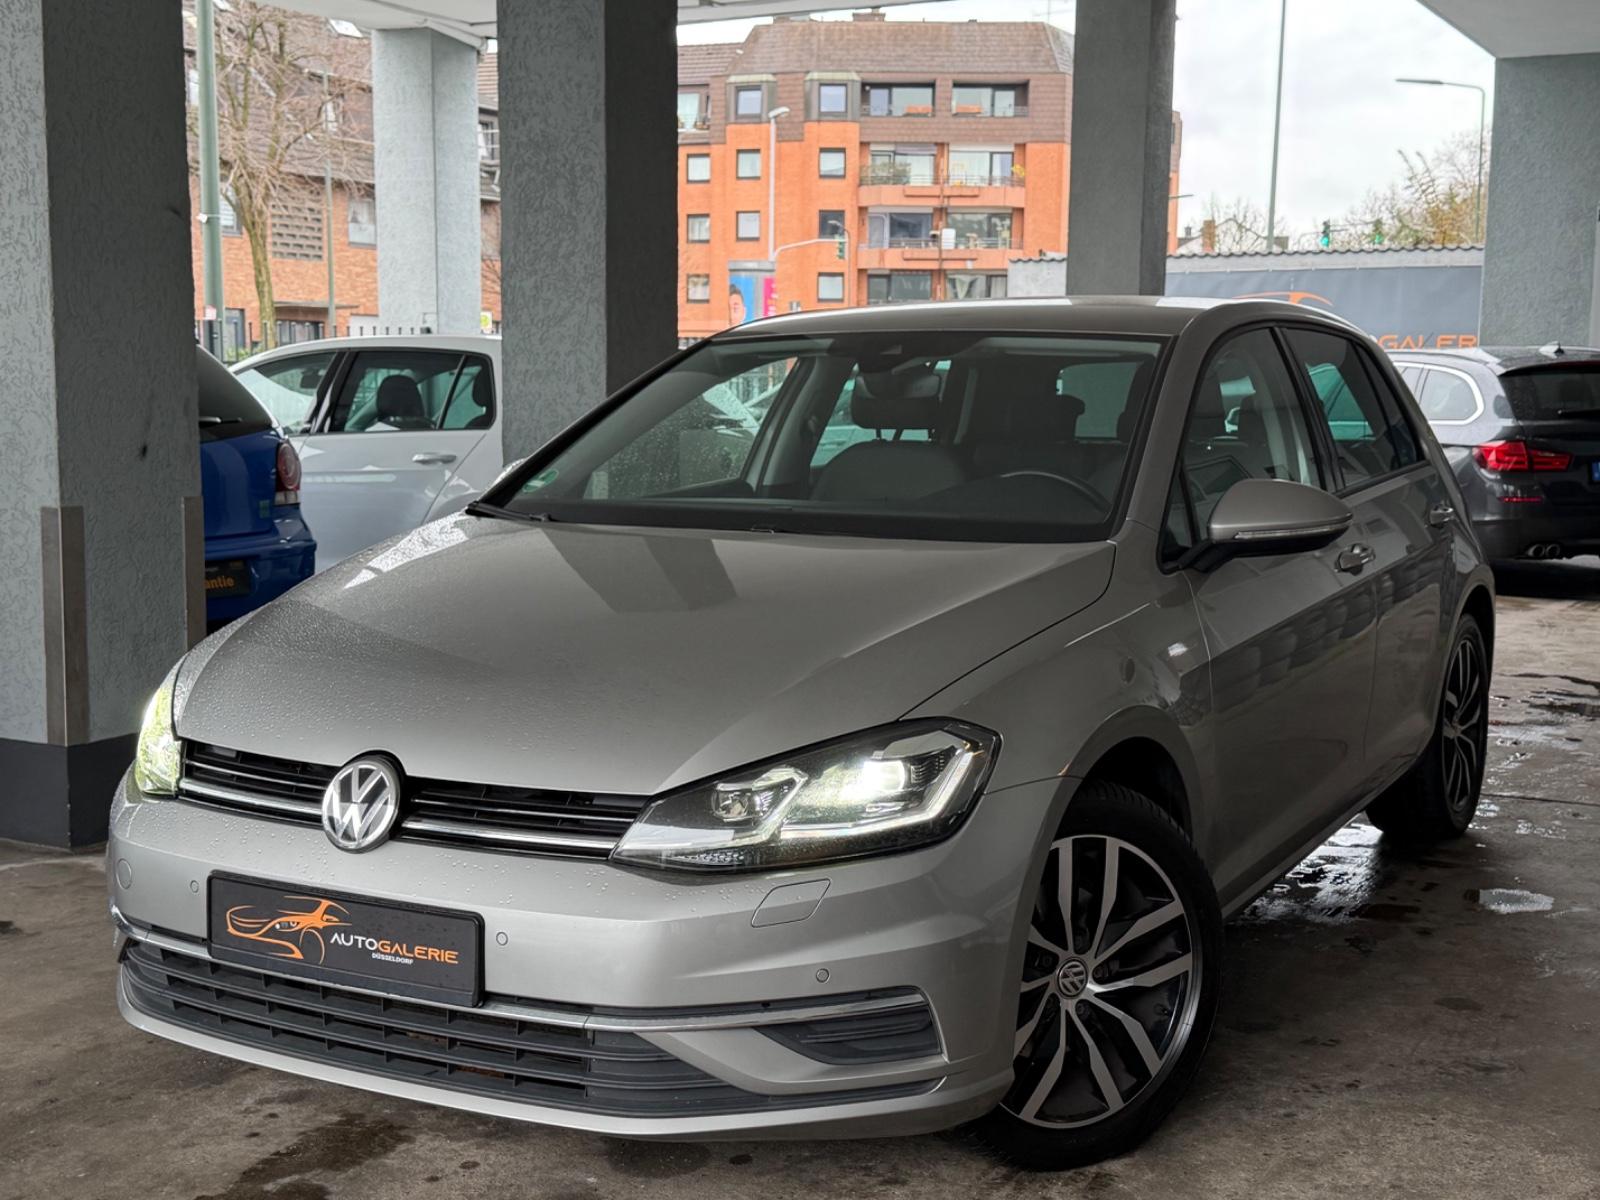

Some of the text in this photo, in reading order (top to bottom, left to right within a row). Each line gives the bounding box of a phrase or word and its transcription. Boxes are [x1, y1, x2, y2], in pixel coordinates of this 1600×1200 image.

[323, 762, 394, 849] VW
[330, 932, 459, 964] AUTOGALERIE
[372, 952, 414, 965] DÜSSELDORF
